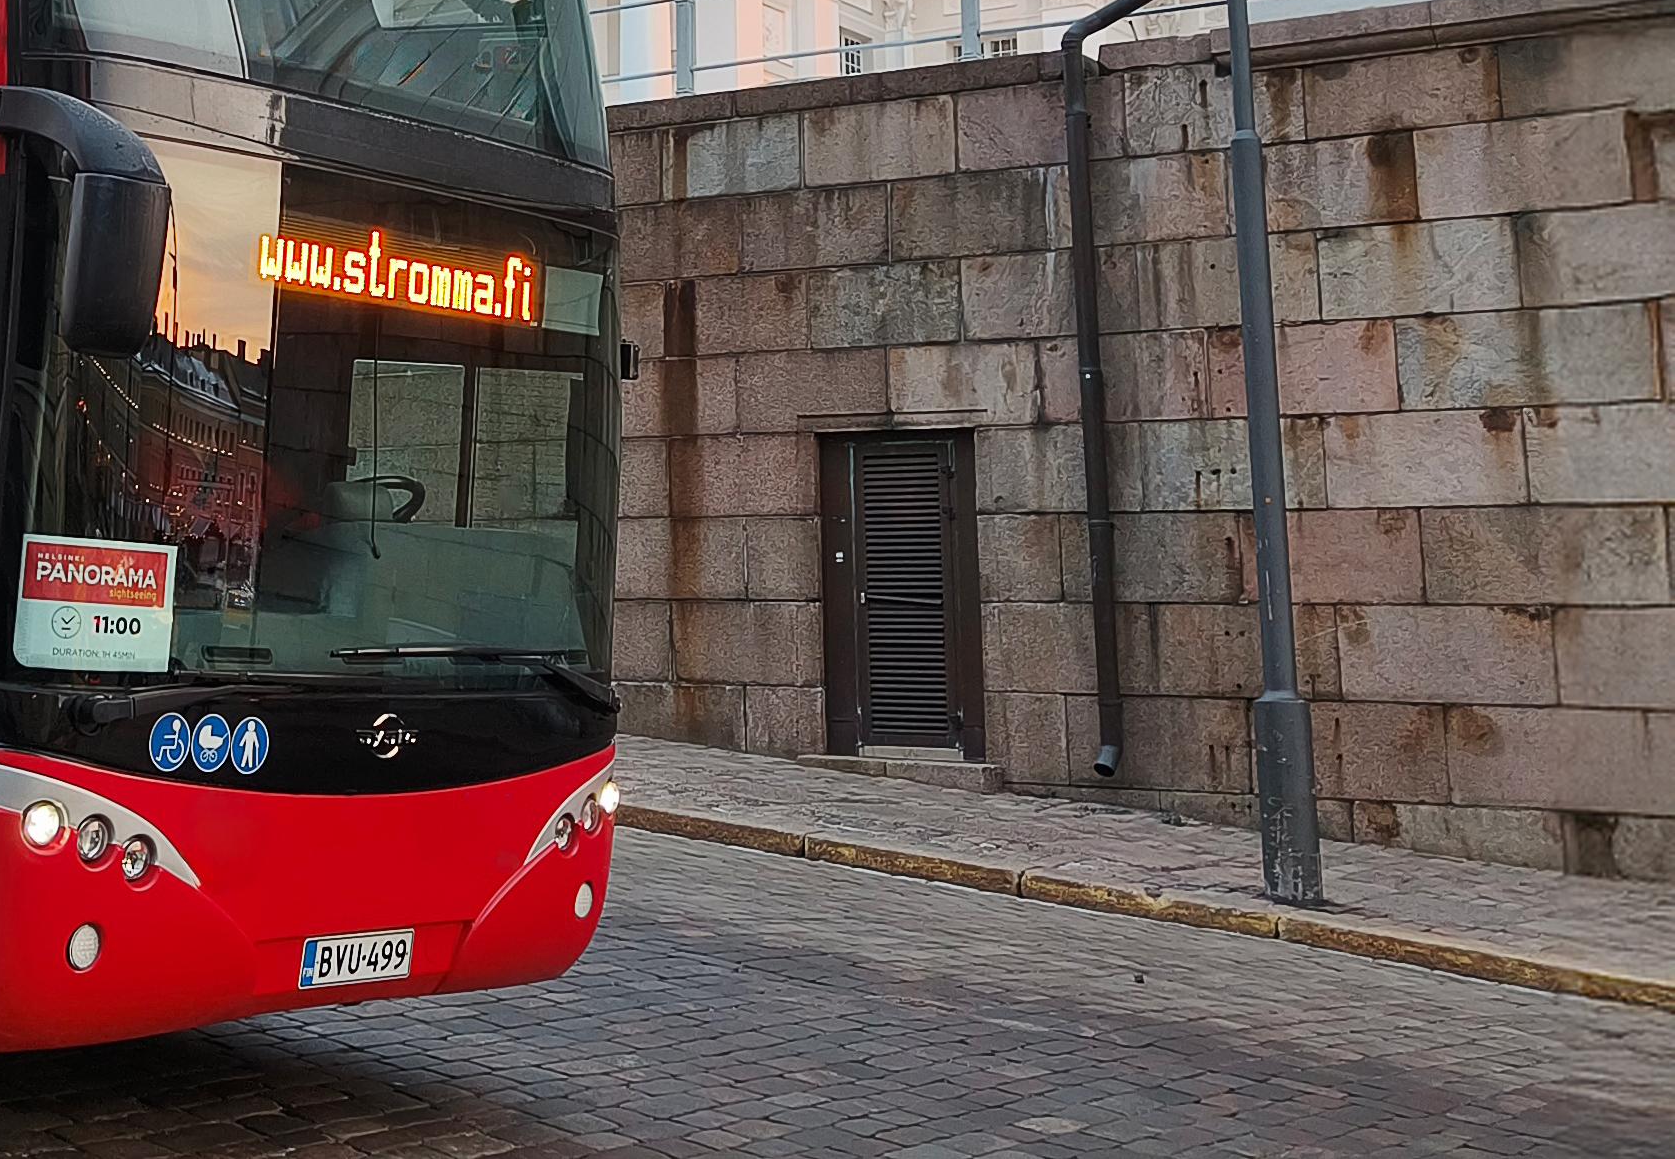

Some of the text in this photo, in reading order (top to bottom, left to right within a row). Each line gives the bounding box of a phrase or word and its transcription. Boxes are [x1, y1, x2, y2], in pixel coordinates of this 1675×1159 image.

[259, 230, 533, 322] www.stromma.fi
[37, 552, 85, 562] HELSINKI
[36, 561, 157, 590] PANORAMA
[108, 588, 157, 602] sightseeing
[93, 615, 141, 636] 11:00
[318, 938, 408, 979] BVU-499
